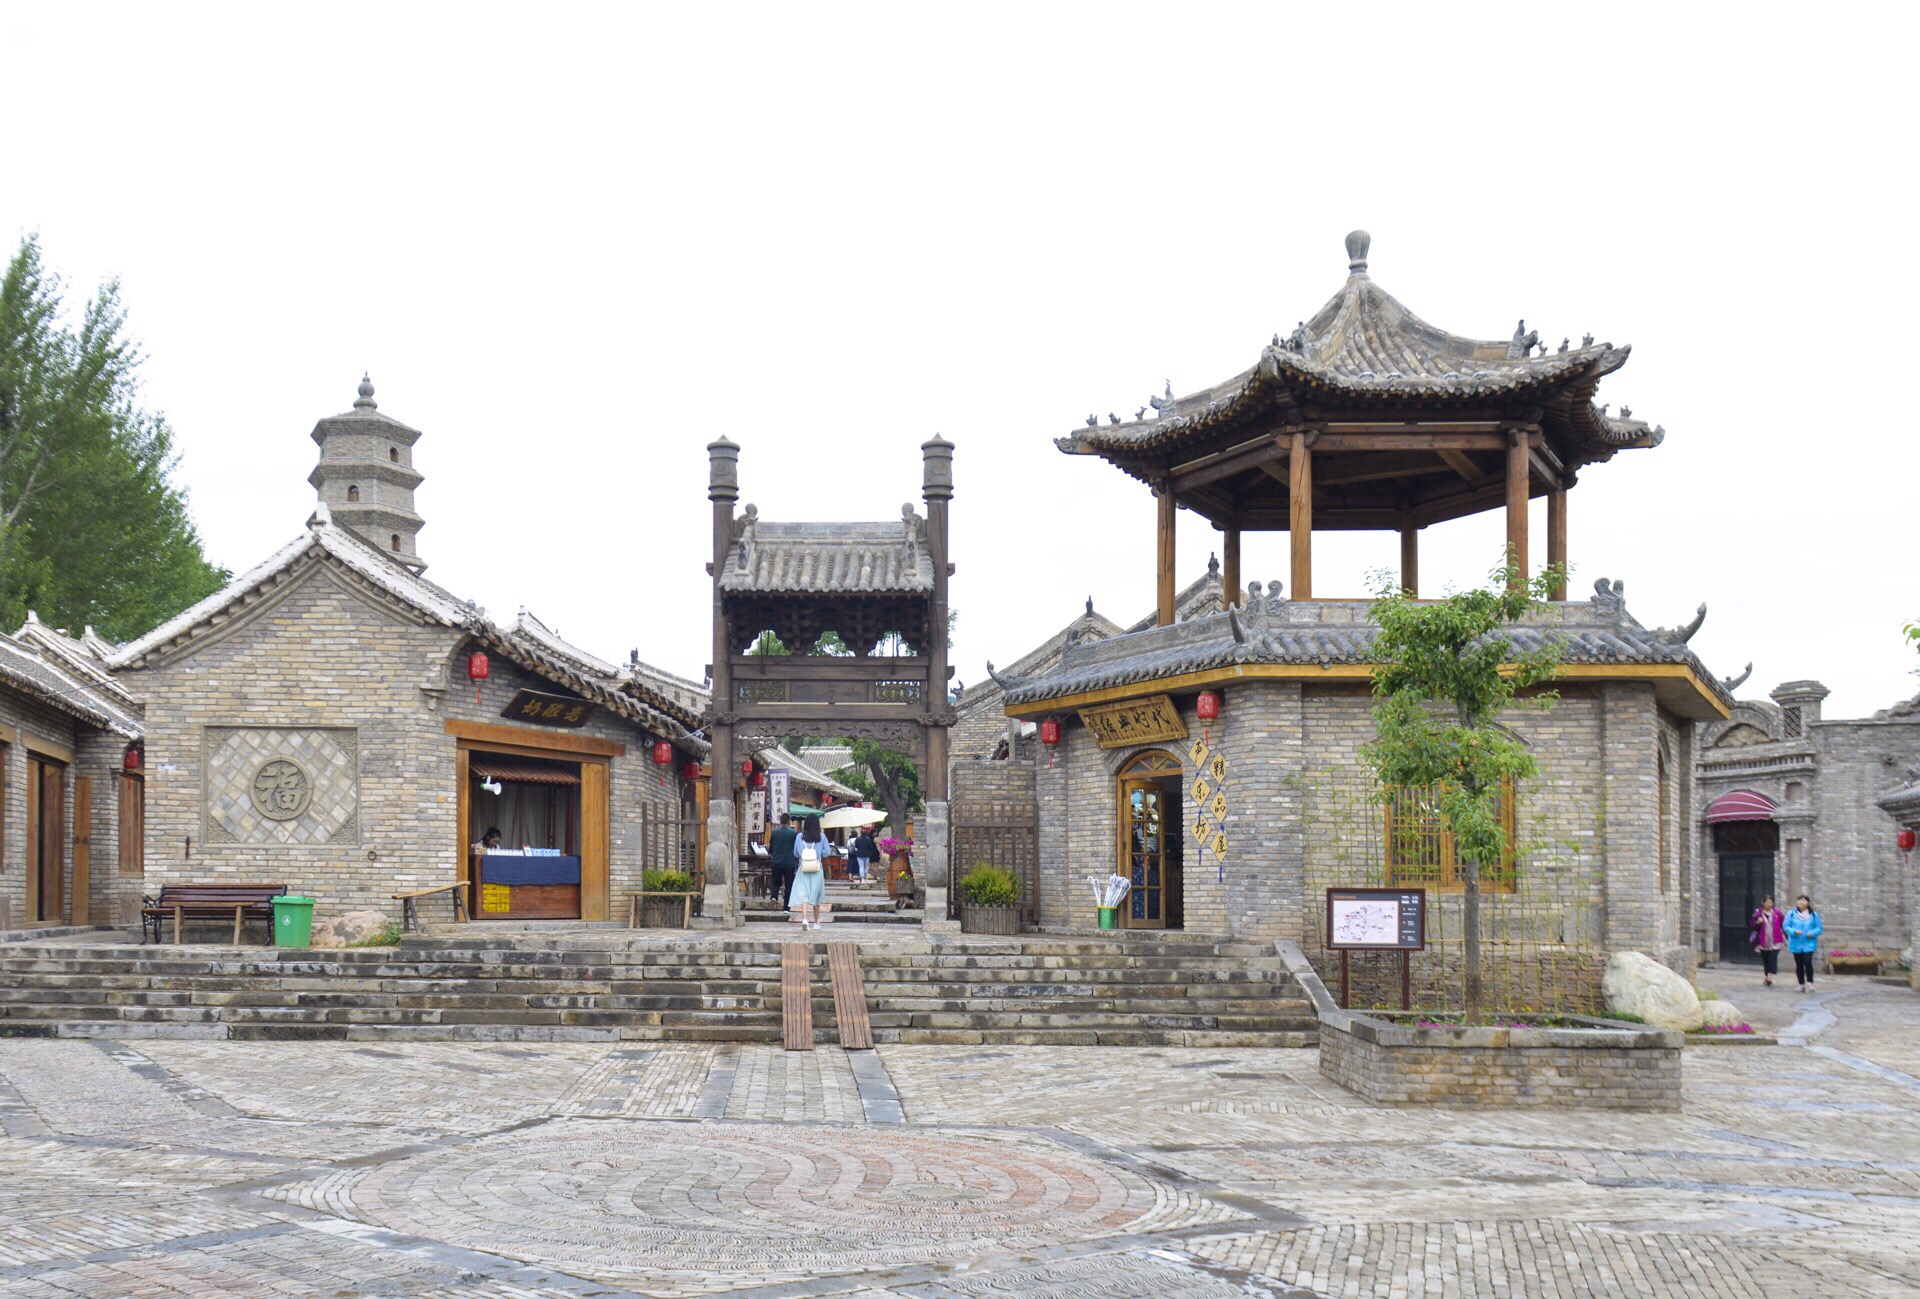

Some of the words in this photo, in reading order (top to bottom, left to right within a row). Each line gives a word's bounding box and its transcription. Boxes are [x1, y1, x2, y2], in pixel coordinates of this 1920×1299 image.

[1100, 706, 1171, 733] 经典时代
[254, 766, 306, 812] 福
[1195, 741, 1207, 840] 声乐坊
[1213, 760, 1227, 853] 精品屋
